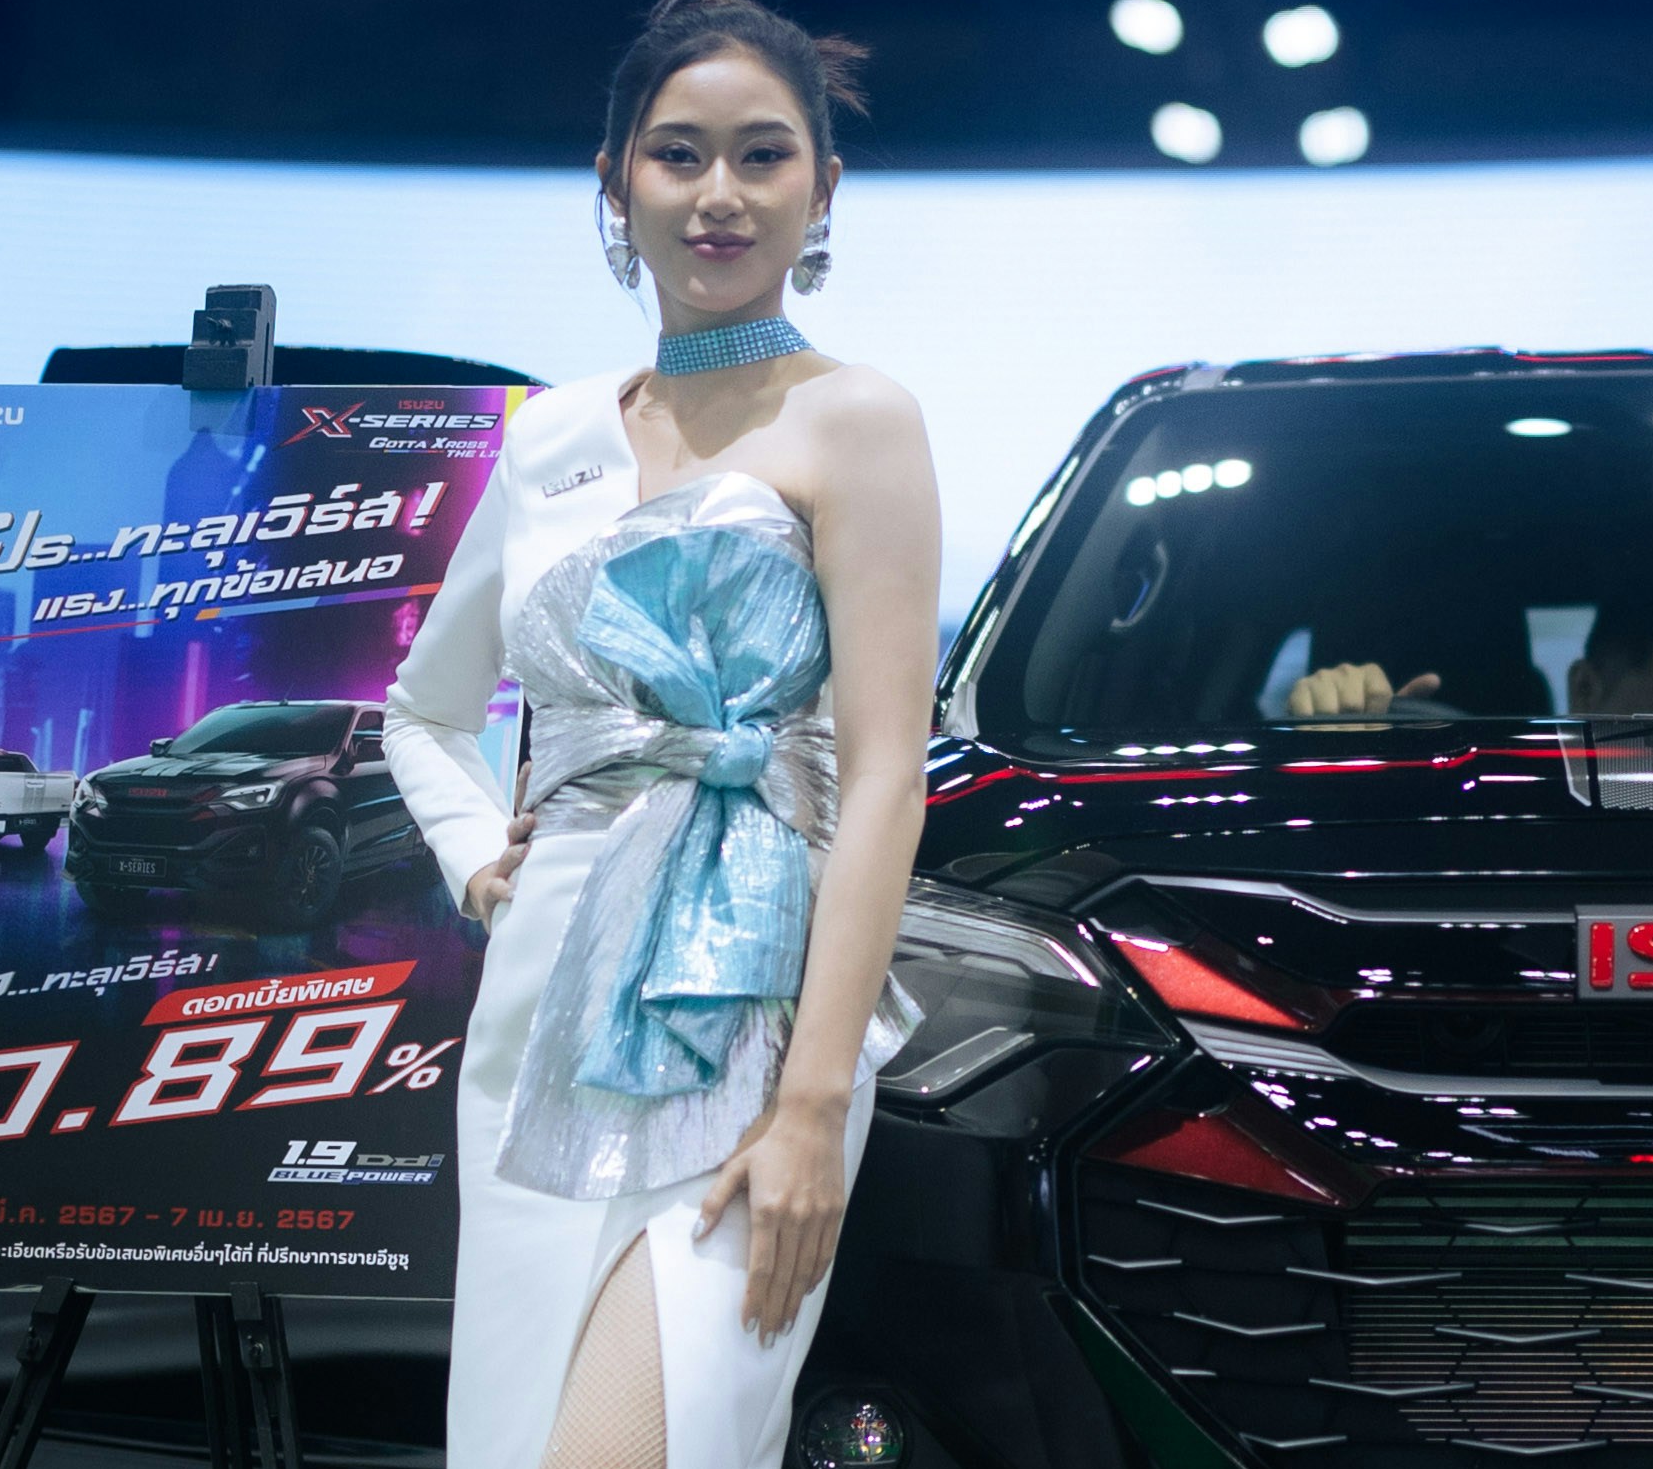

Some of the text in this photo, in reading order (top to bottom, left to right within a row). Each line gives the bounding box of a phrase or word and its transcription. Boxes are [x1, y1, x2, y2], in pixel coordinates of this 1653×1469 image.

[398, 400, 445, 410] ISUZU
[280, 400, 501, 447] X-SERIES
[446, 450, 478, 458] THE
[181, 974, 374, 1016] ดอกเบี้ยพิเศษ
[281, 1140, 357, 1166] 1.9
[273, 1170, 433, 1182] BLUE POWER
[59, 1206, 136, 1226] 2567
[170, 1208, 187, 1227] 7
[277, 1210, 355, 1230] 2567
